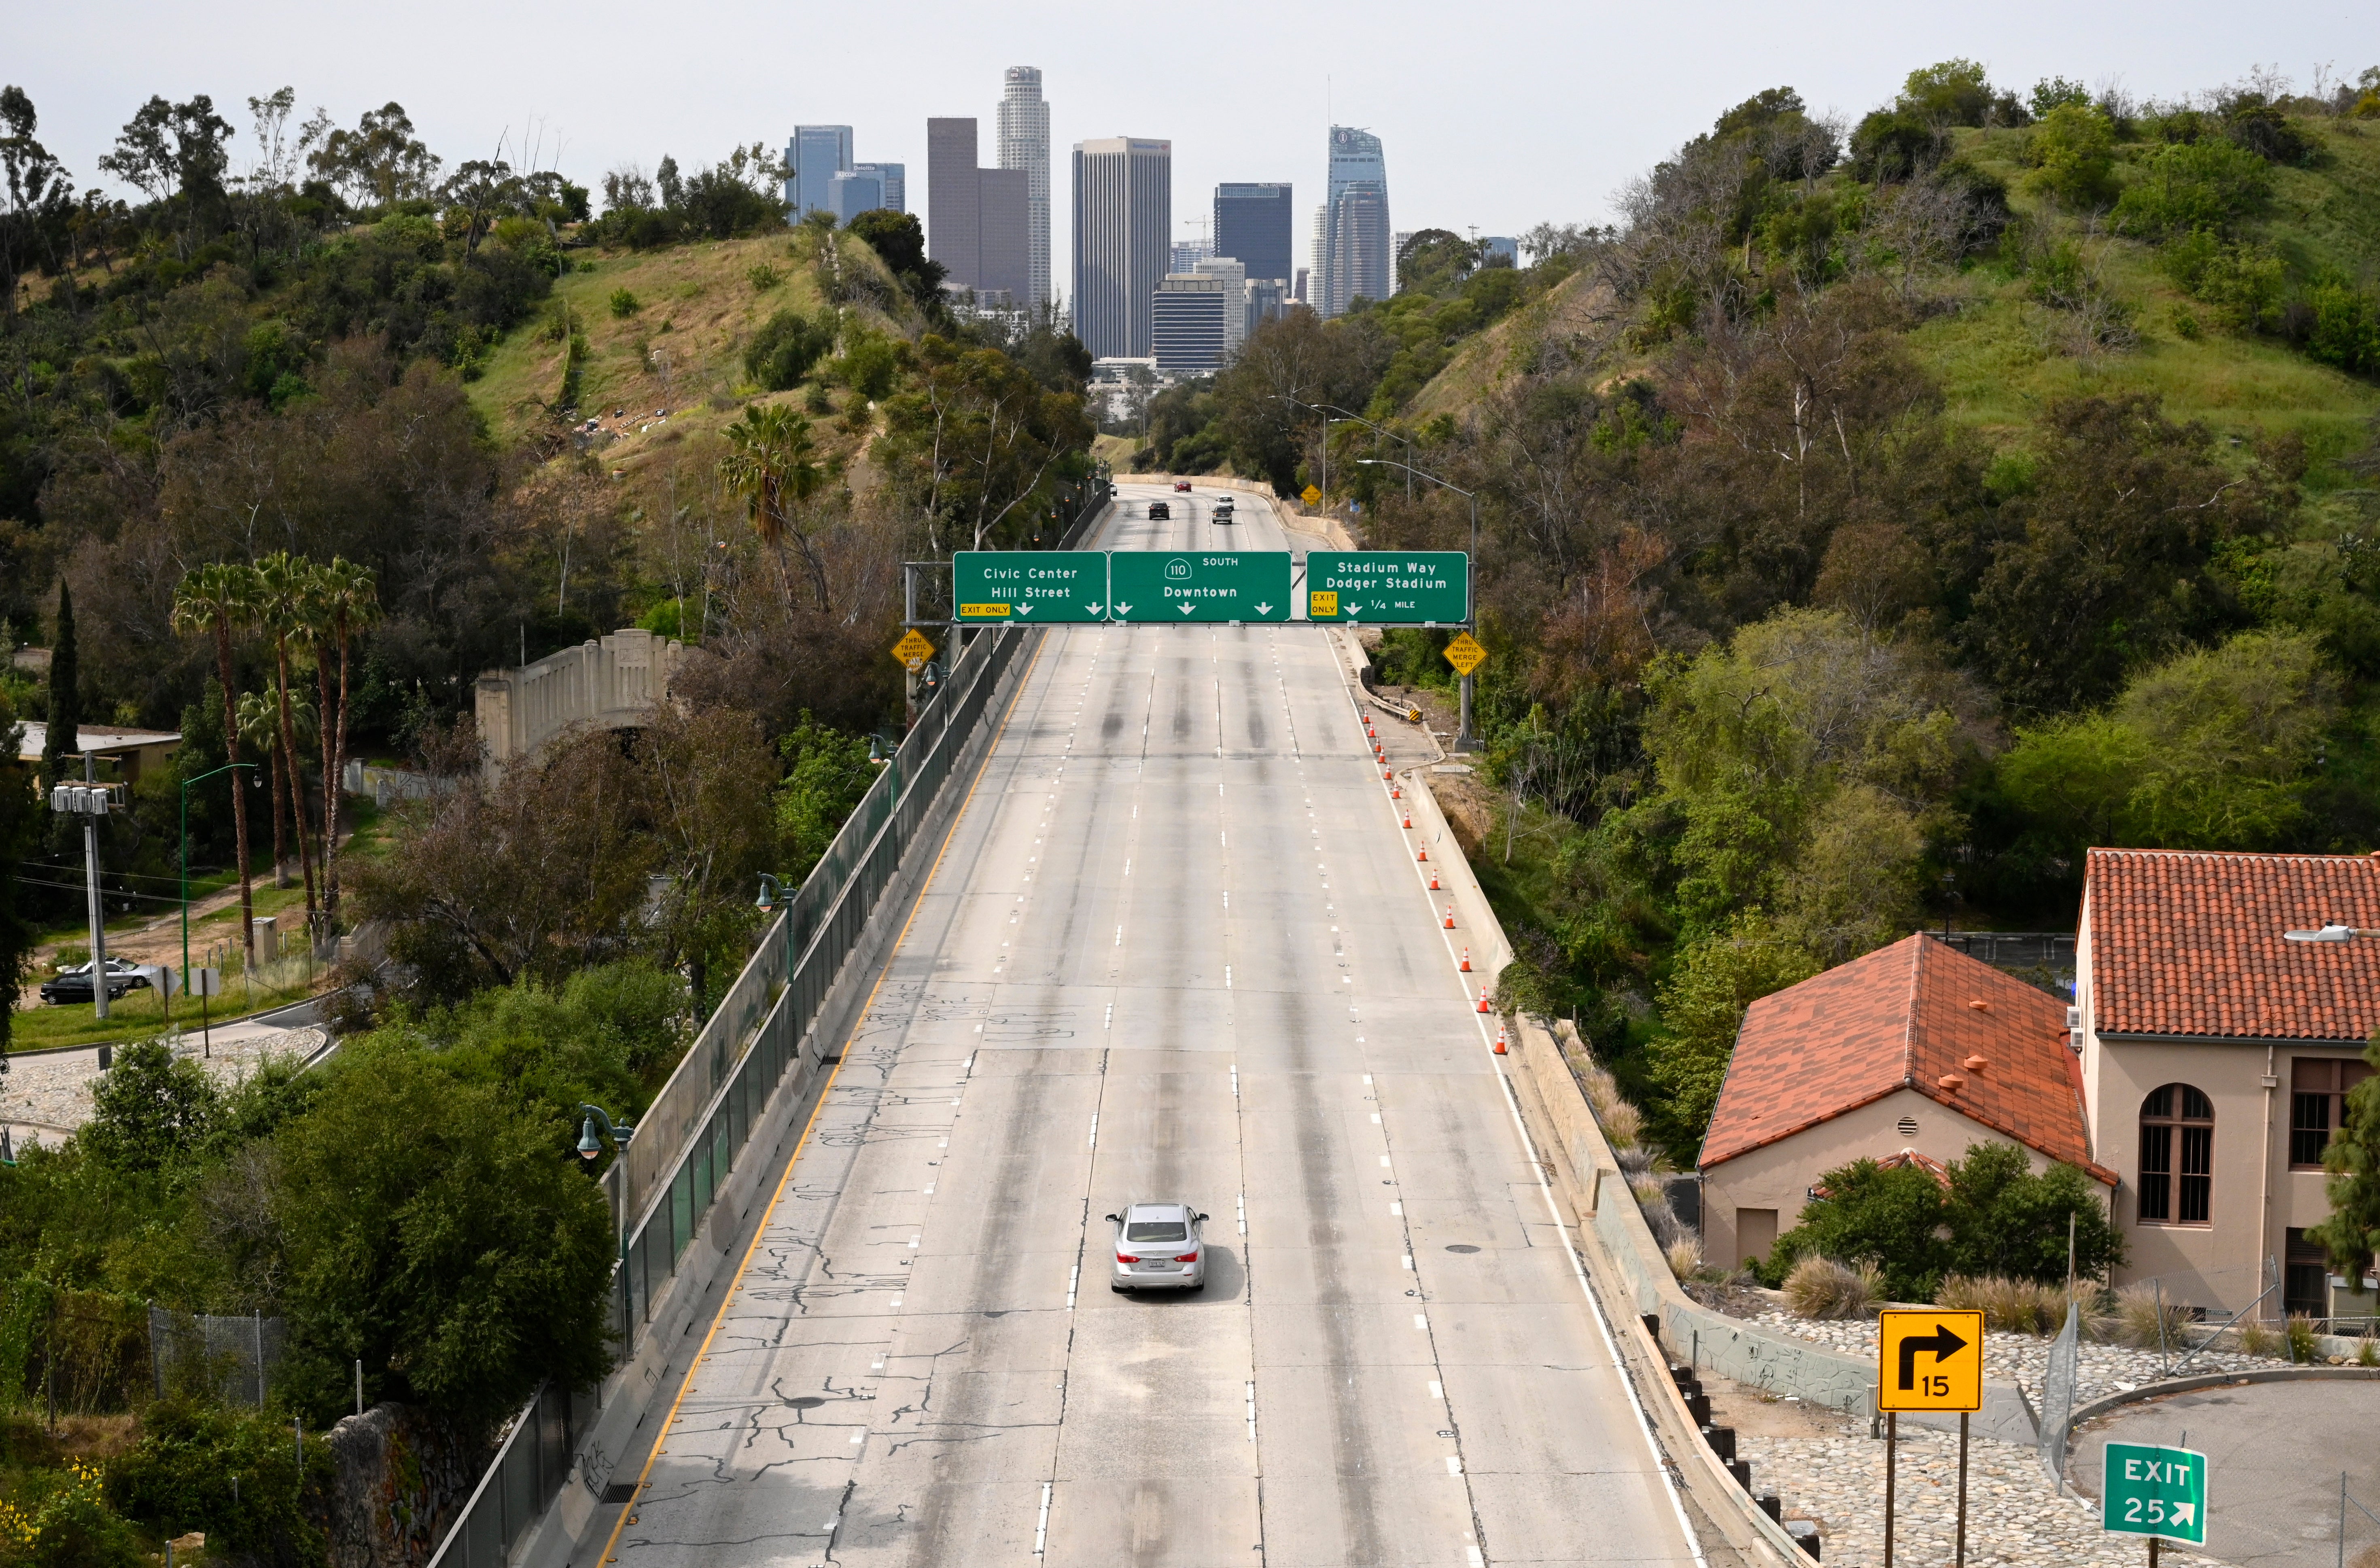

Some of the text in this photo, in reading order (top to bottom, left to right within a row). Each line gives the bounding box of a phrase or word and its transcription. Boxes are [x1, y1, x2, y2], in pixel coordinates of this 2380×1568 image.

[984, 568, 1077, 578] Civic Center
[1171, 565, 1186, 575] 110
[1338, 562, 1436, 575] Stadium Way
[1327, 578, 1446, 591] Dodger Stadium
[992, 587, 1070, 598] Hill Street
[1165, 587, 1237, 597] Downtown
[1922, 1376, 1949, 1396] 15
[2125, 1459, 2190, 1486] EXIT
[2124, 1498, 2164, 1524] 25
